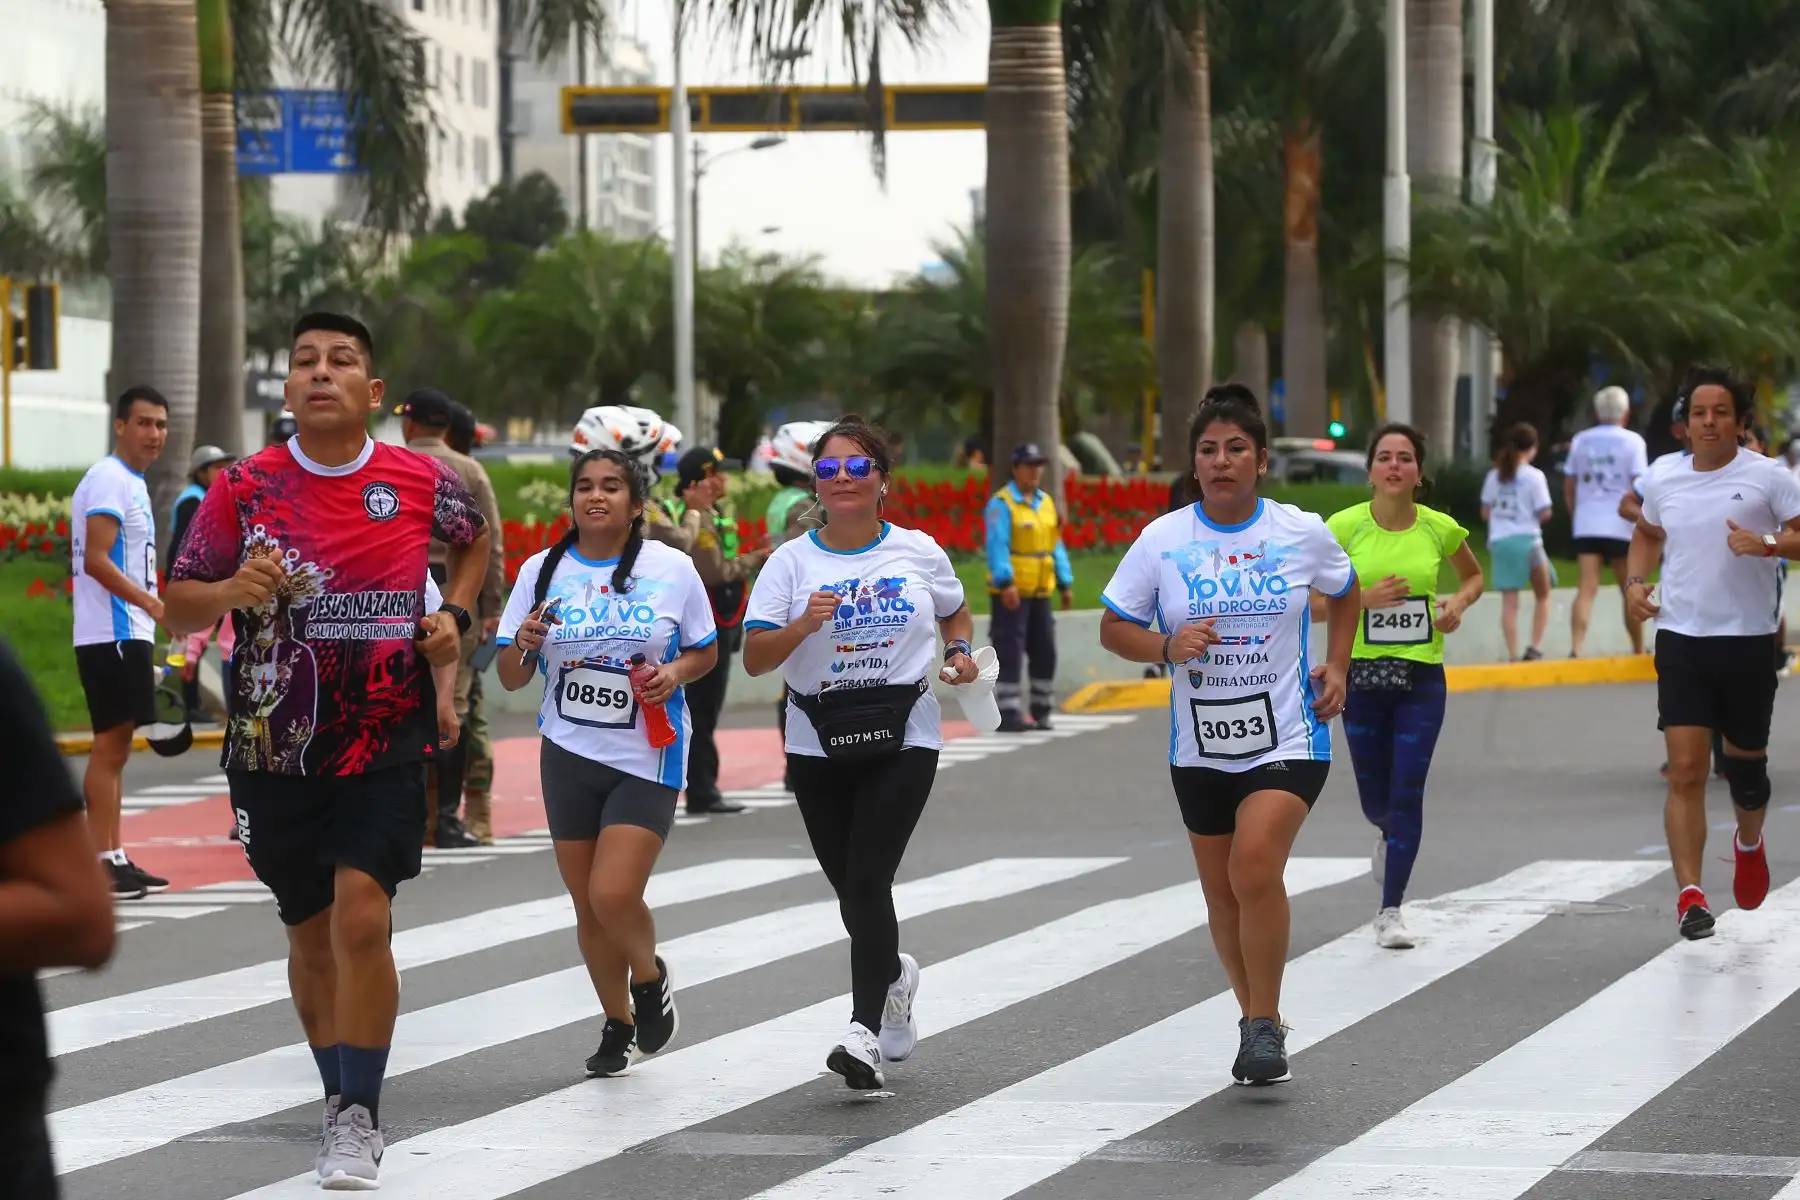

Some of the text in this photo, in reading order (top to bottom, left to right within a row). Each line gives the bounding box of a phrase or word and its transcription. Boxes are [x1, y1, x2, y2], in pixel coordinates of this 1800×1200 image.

[308, 590, 417, 620] JESUS NAZARENO
[1188, 597, 1287, 616] SIN DROGAS
[834, 614, 908, 631] SIN DROGAS
[1371, 613, 1425, 628] 2487
[305, 622, 351, 639] CAUTIVO
[351, 623, 368, 639] DE
[555, 625, 652, 640] SIN DROGAS
[1214, 652, 1270, 666] DEVIDA
[1206, 672, 1278, 687] DIRANDRO
[566, 682, 629, 709] 0859
[1201, 716, 1265, 740] 3033
[830, 729, 893, 746] 0907 M STL
